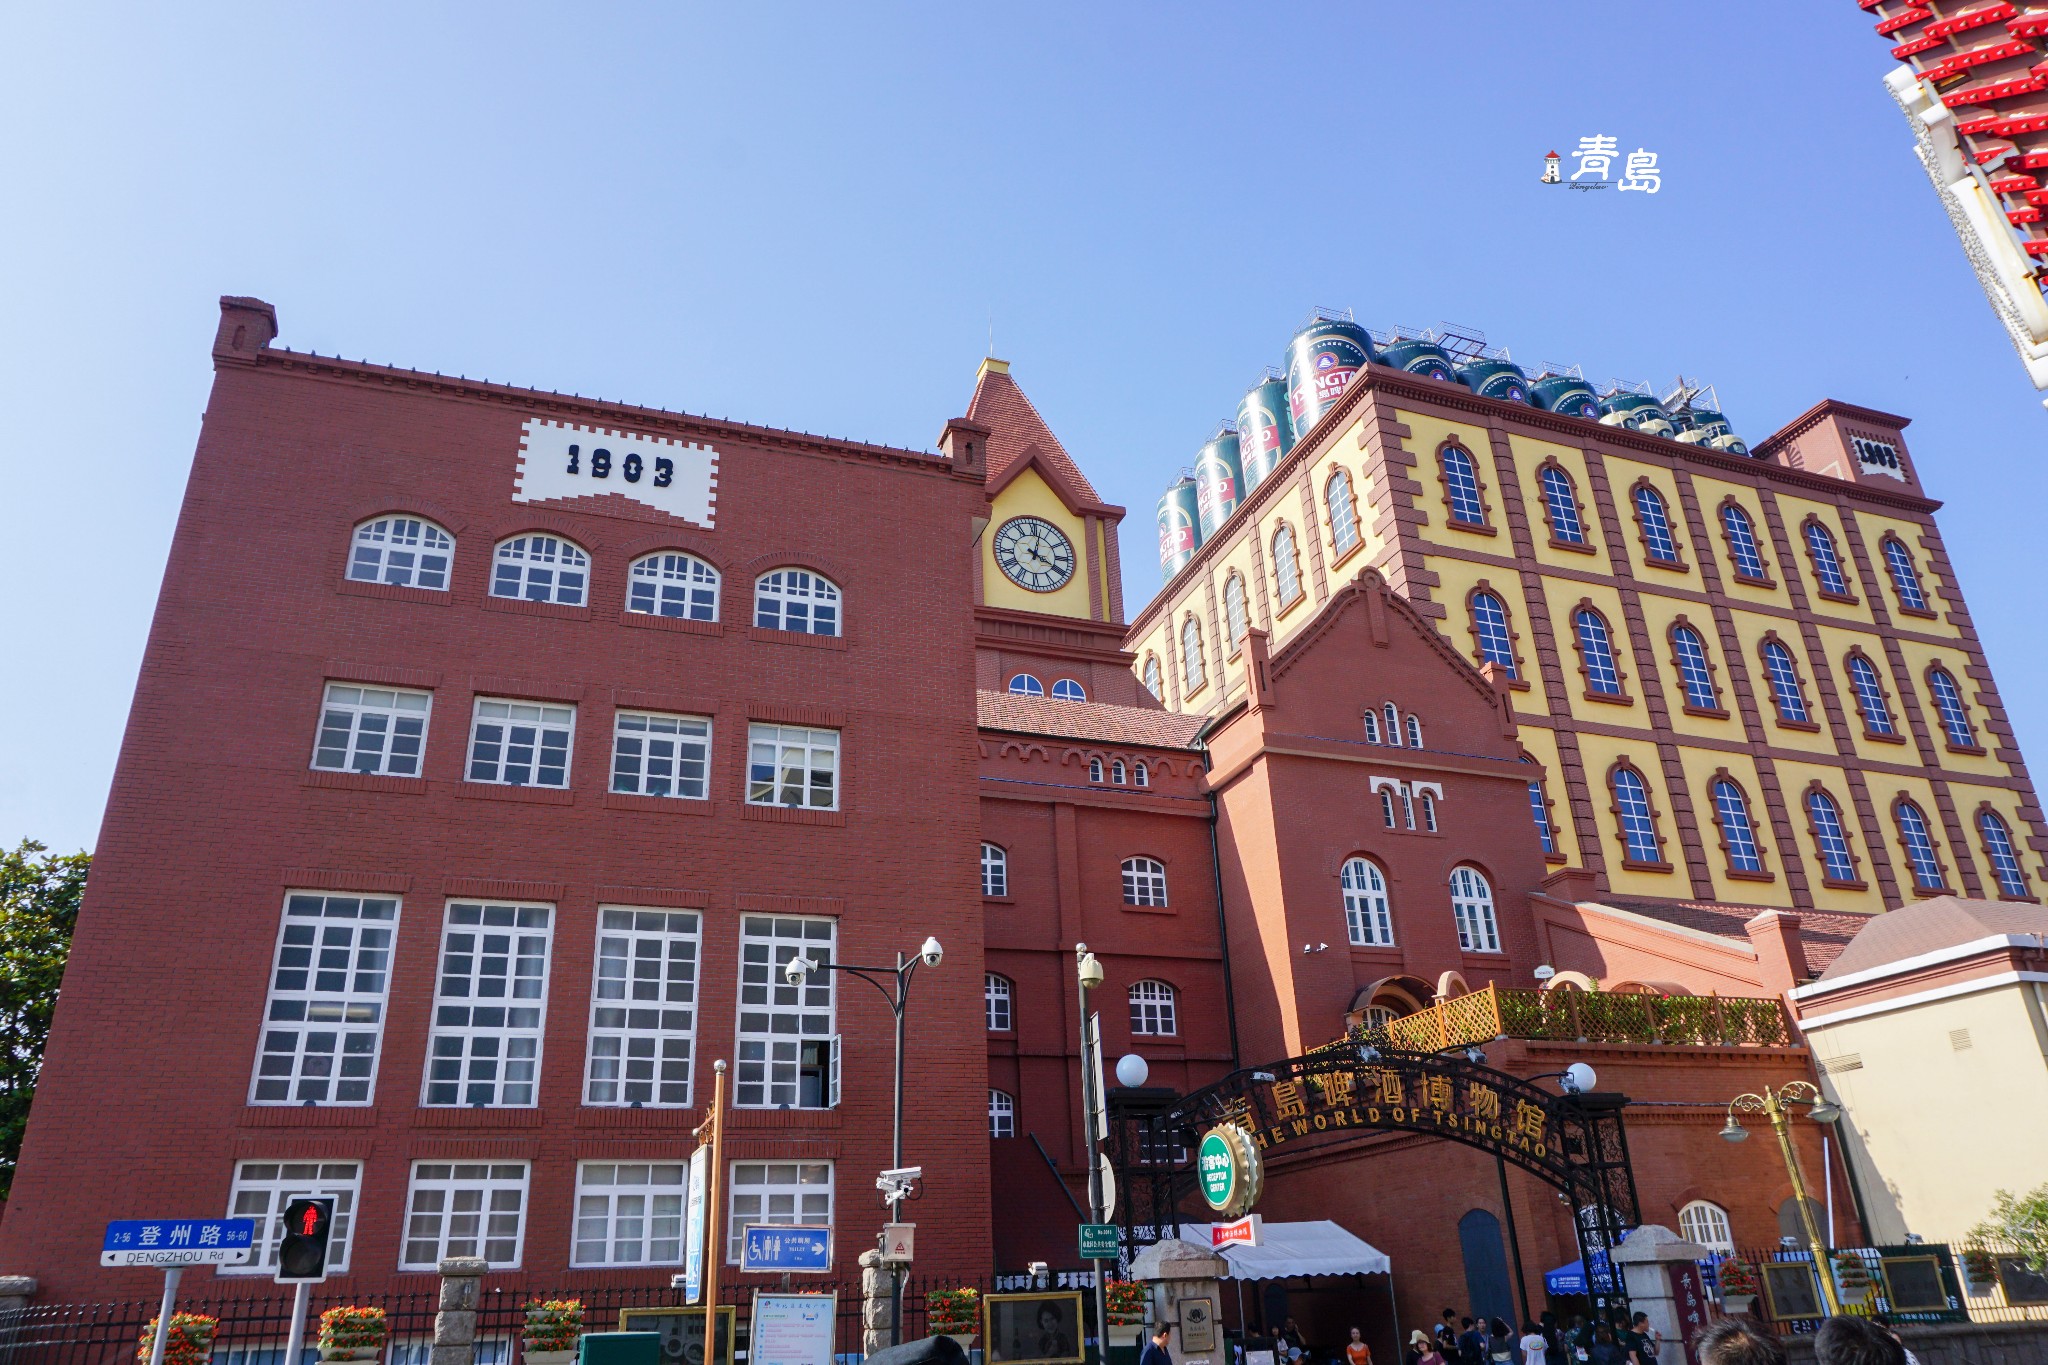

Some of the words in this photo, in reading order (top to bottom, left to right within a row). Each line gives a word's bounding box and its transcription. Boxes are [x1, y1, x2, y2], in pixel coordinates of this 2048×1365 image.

[566, 444, 674, 487] 1903
[1854, 439, 1898, 469] 1903
[1254, 1126, 1285, 1151] HE
[1290, 1107, 1381, 1137] WORLD
[1393, 1107, 1420, 1123] OF
[1434, 1110, 1547, 1159] TSINGTAO
[1201, 1152, 1230, 1172] 游客中心
[113, 1232, 132, 1244] 2-56
[138, 1224, 222, 1246] 登州路
[226, 1230, 248, 1241] 56-60
[126, 1250, 203, 1263] DENGZHOU
[209, 1251, 224, 1260] Rd
